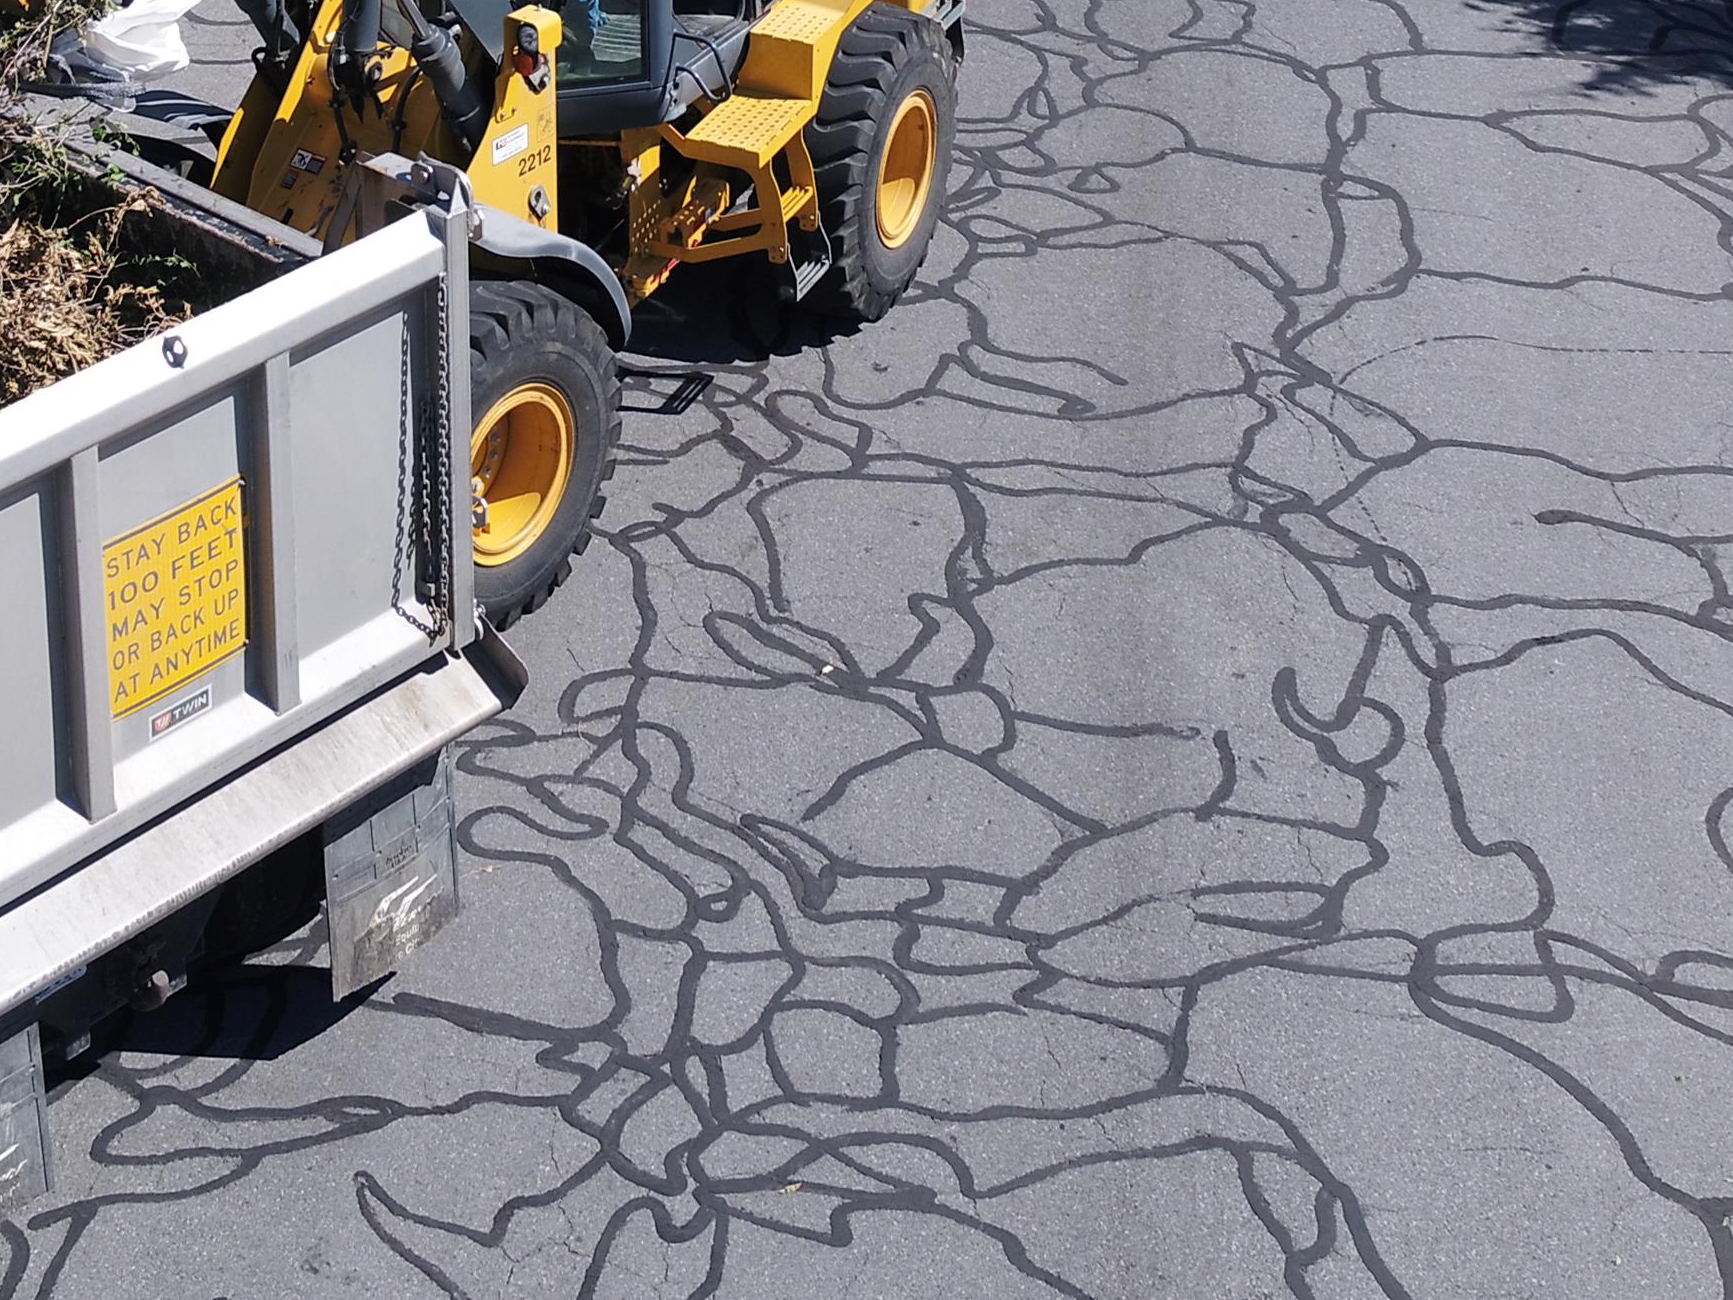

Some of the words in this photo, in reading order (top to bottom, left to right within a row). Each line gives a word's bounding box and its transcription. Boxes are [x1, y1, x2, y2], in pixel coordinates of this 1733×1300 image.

[518, 144, 552, 178] 2212
[106, 534, 166, 579] STAY
[177, 496, 238, 544] BACK
[108, 572, 159, 611] 100
[171, 528, 238, 580] FEET
[112, 597, 165, 642] MAY
[179, 558, 240, 607] STOP
[112, 642, 140, 671] OR
[150, 607, 205, 652] BACK
[214, 587, 240, 616] UP
[114, 672, 140, 704] AT
[150, 618, 241, 685] ANYTIME
[173, 693, 207, 720] TWIN
